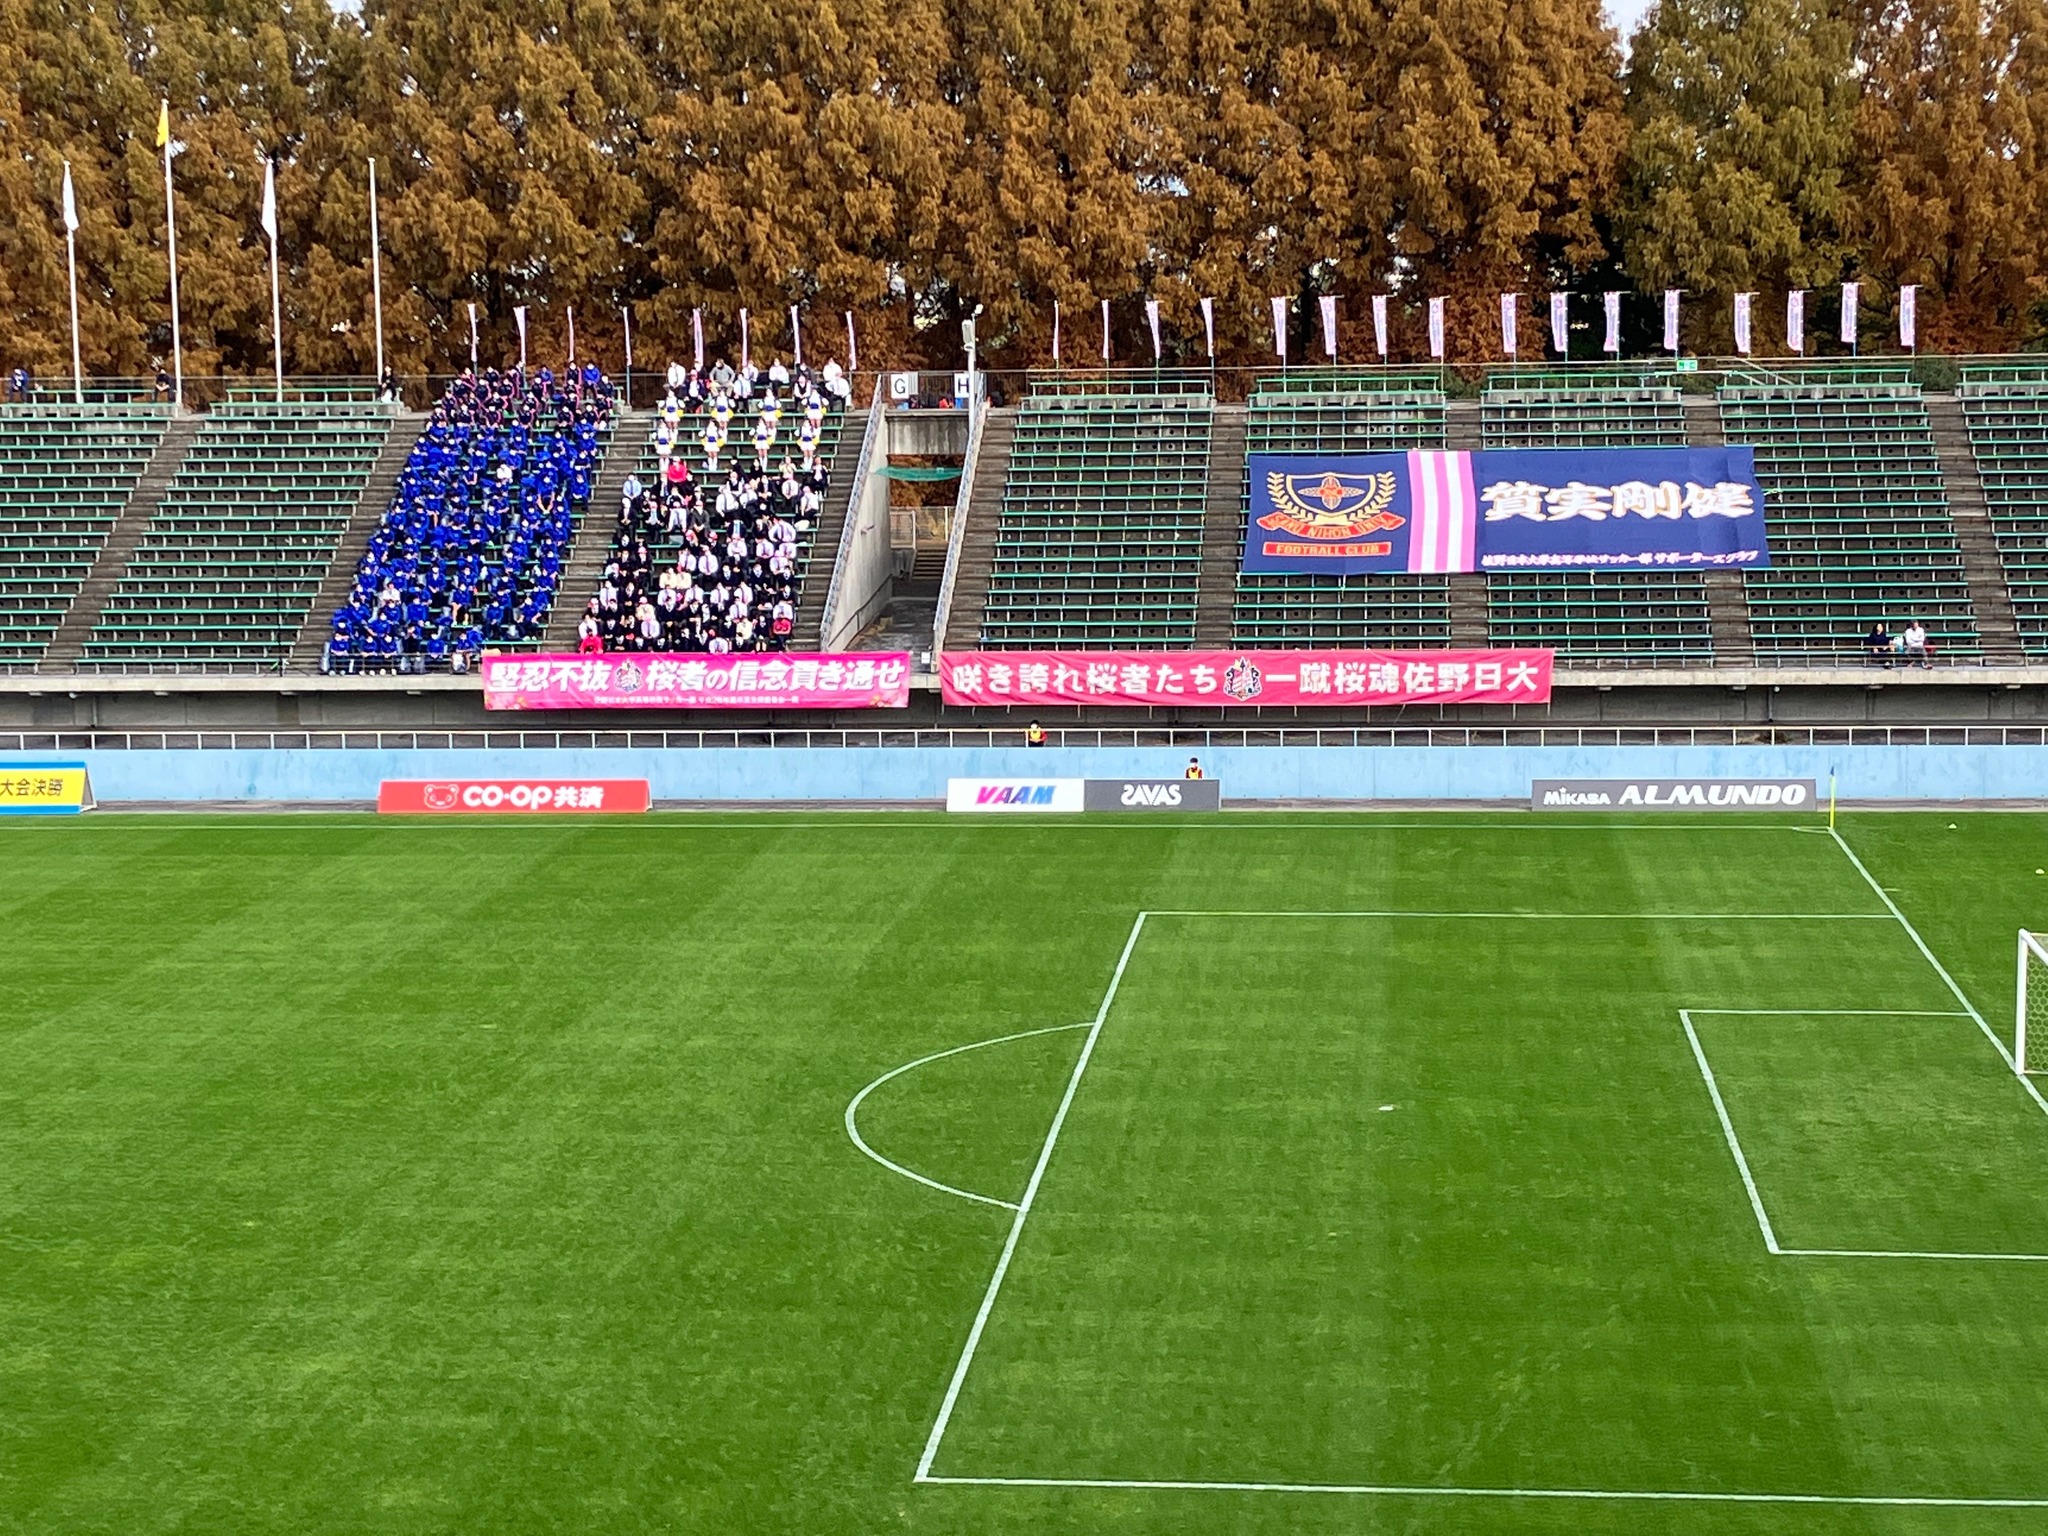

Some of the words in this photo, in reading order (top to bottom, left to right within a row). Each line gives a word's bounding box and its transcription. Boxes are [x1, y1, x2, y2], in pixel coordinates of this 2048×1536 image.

[894, 378, 906, 394] G
[957, 378, 969, 394] H
[1480, 480, 1754, 521] 質実剛健
[1307, 526, 1353, 539] NIHON
[1276, 543, 1341, 555] FOOTBALL
[1345, 543, 1380, 555] CLUB
[488, 660, 613, 693] 堅忍不抜
[645, 660, 905, 691] 桜者の信念貫き通せ
[952, 663, 1217, 695] 咲き誇れ桜者たち
[1265, 661, 1539, 694] 一蹴桜魂佐野日大
[975, 785, 1057, 805] VAAM
[1120, 784, 1182, 806] SAVAS
[1618, 783, 1806, 806] ALMUNDO
